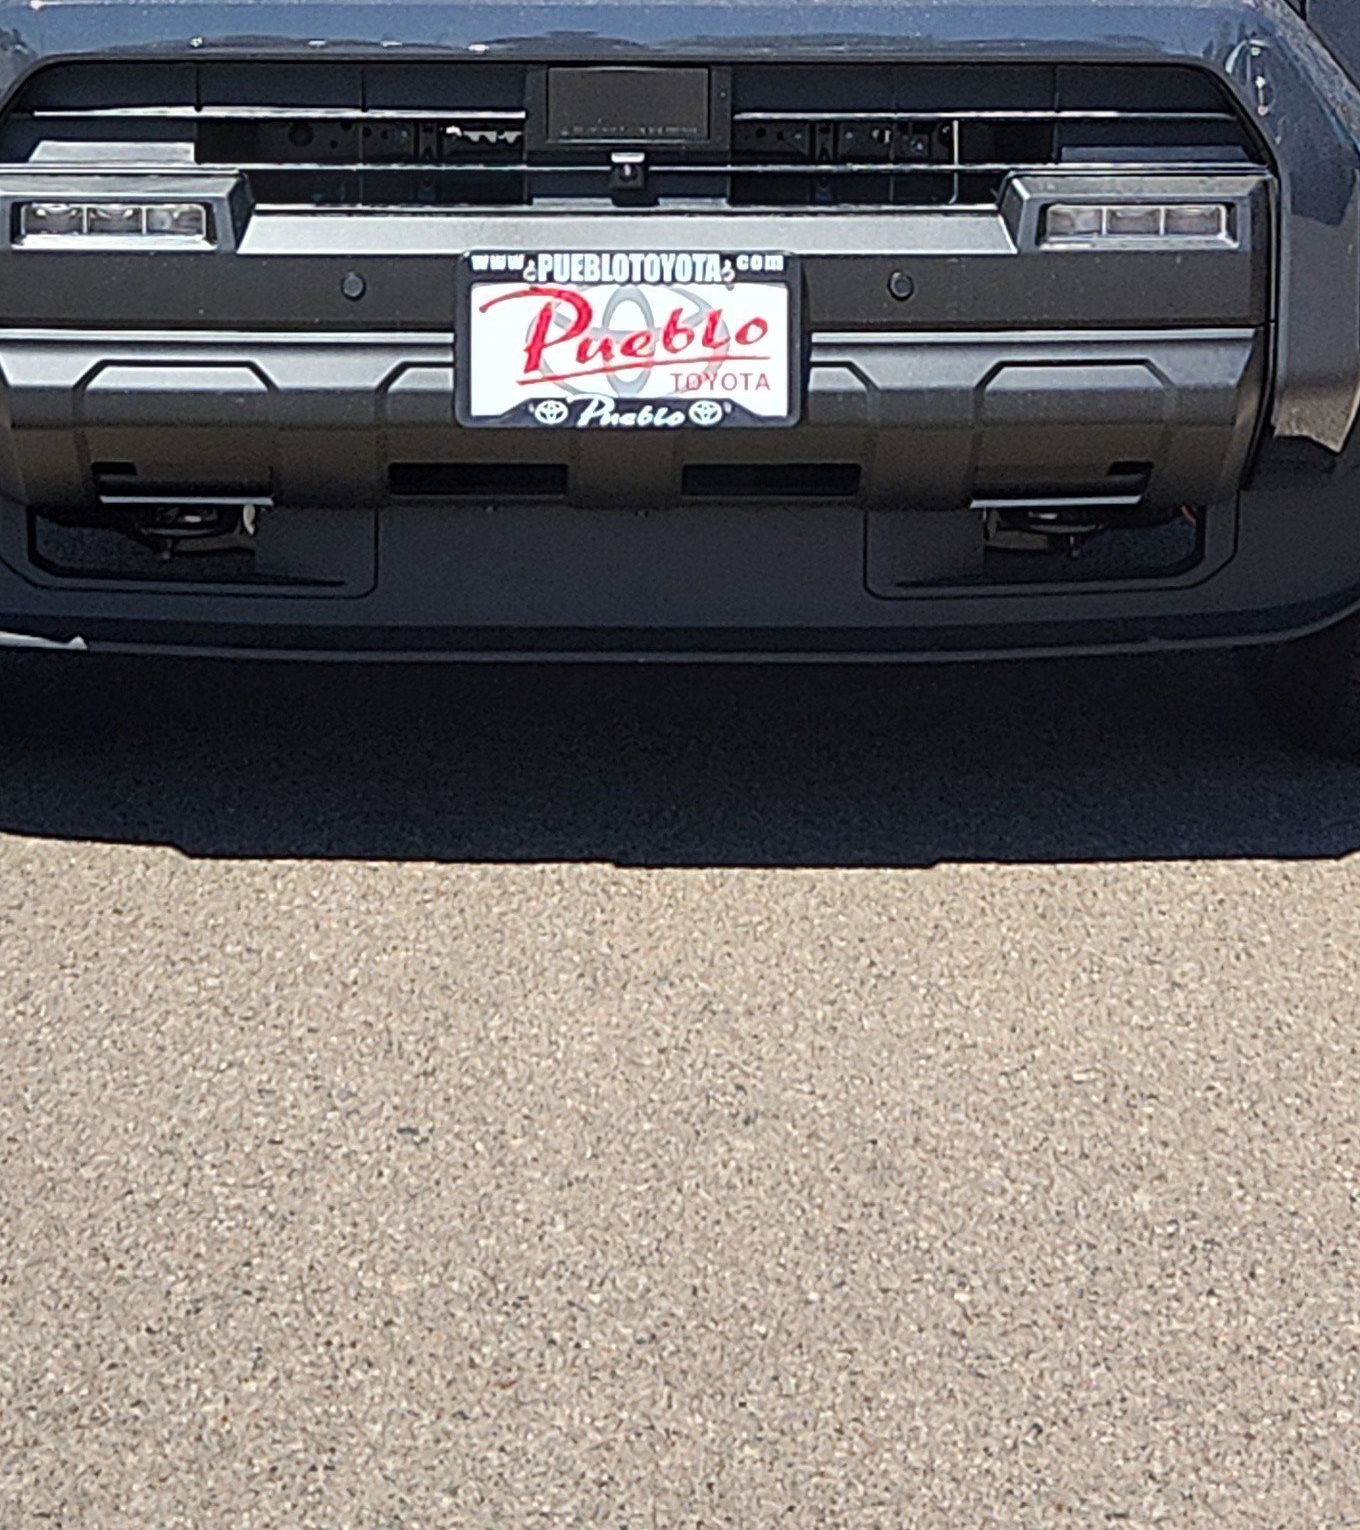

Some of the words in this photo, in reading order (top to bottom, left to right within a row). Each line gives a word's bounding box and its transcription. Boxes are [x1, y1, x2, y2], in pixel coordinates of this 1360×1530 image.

[479, 286, 769, 374] Pueblo
[670, 372, 771, 391] TOYOTA
[566, 394, 687, 427] Pueblo
